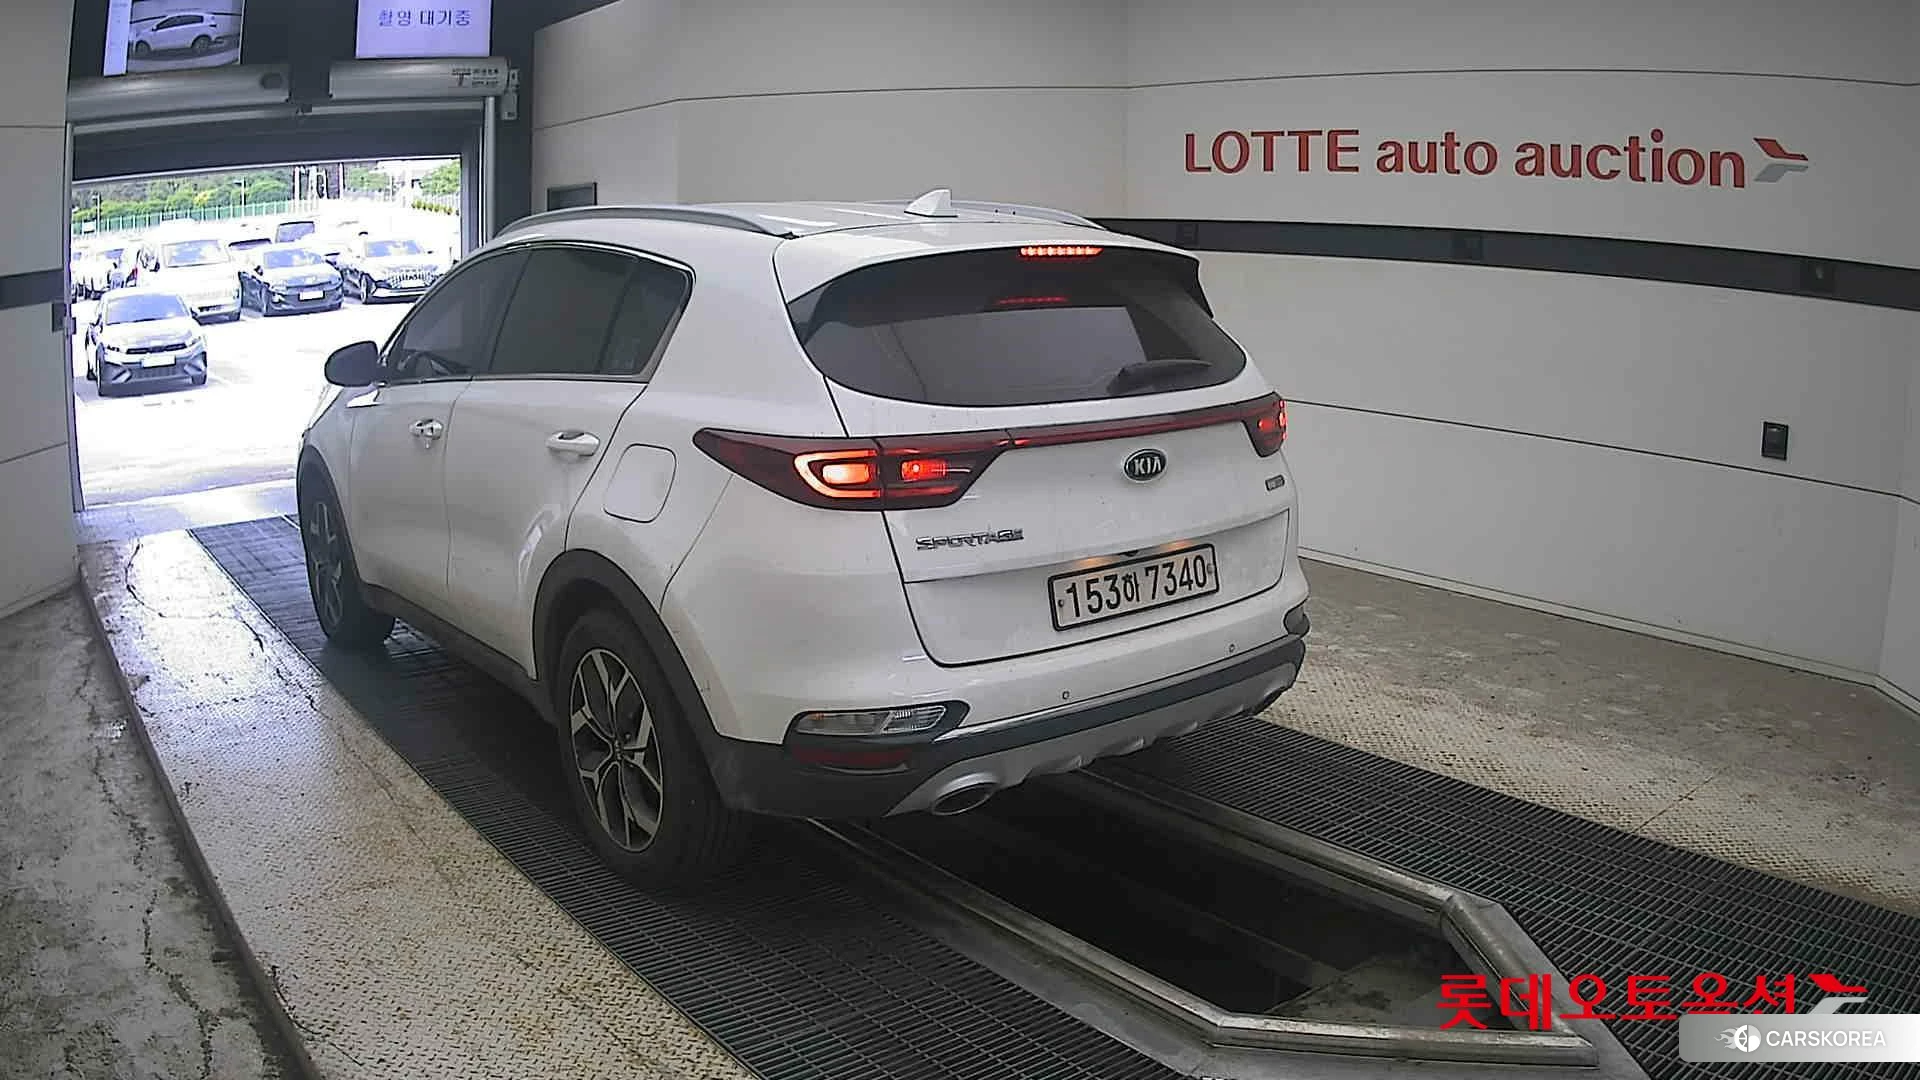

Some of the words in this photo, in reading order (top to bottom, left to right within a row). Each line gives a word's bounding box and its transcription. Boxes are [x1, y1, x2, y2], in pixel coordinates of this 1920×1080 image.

[420, 10, 471, 26] 대기중
[1185, 129, 1360, 173] LOTTE
[1376, 132, 1498, 175] auto
[1514, 128, 1745, 188] auction
[1132, 456, 1162, 476] KIA
[1066, 571, 1140, 617] 153하
[1144, 555, 1207, 600] 7340
